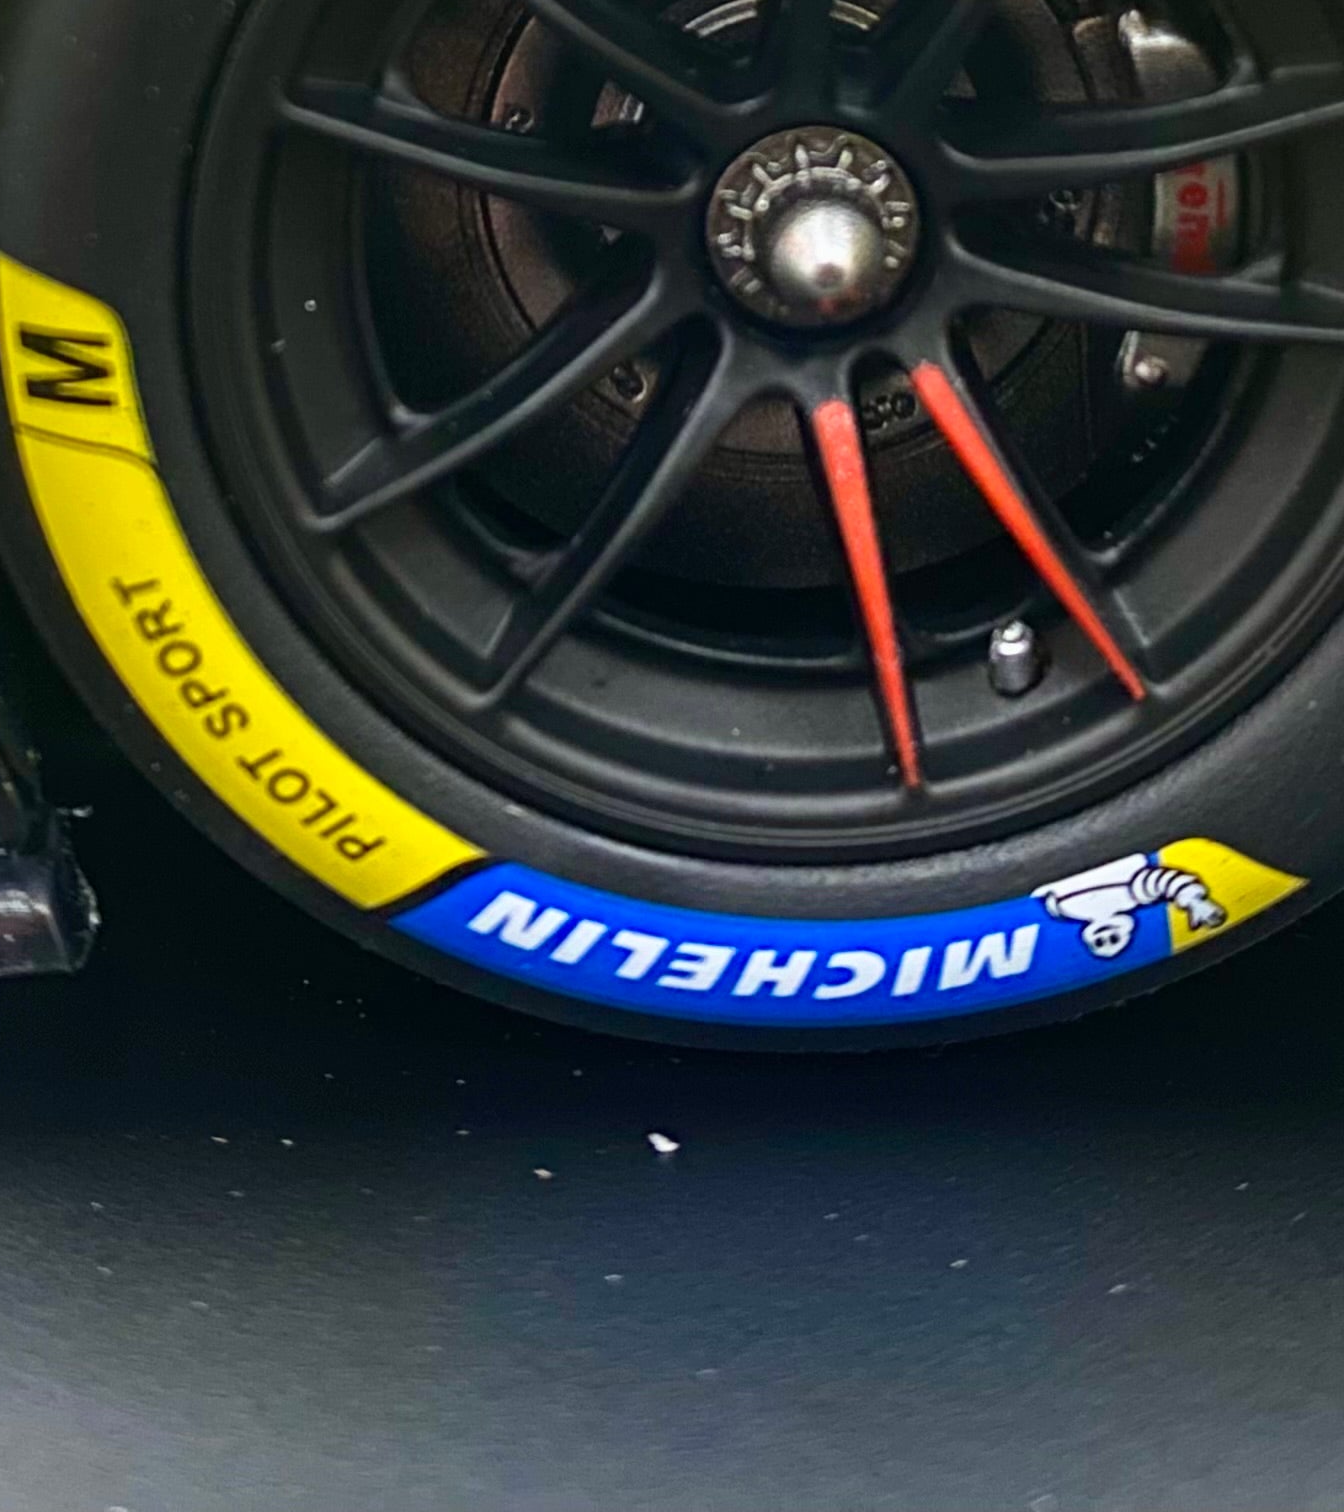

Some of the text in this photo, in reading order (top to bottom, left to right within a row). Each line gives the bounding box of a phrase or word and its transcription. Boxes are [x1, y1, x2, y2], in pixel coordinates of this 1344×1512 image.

[20, 322, 116, 407] M
[111, 577, 386, 863] PILOT SPORT
[468, 890, 1039, 1001] MICHELIN
